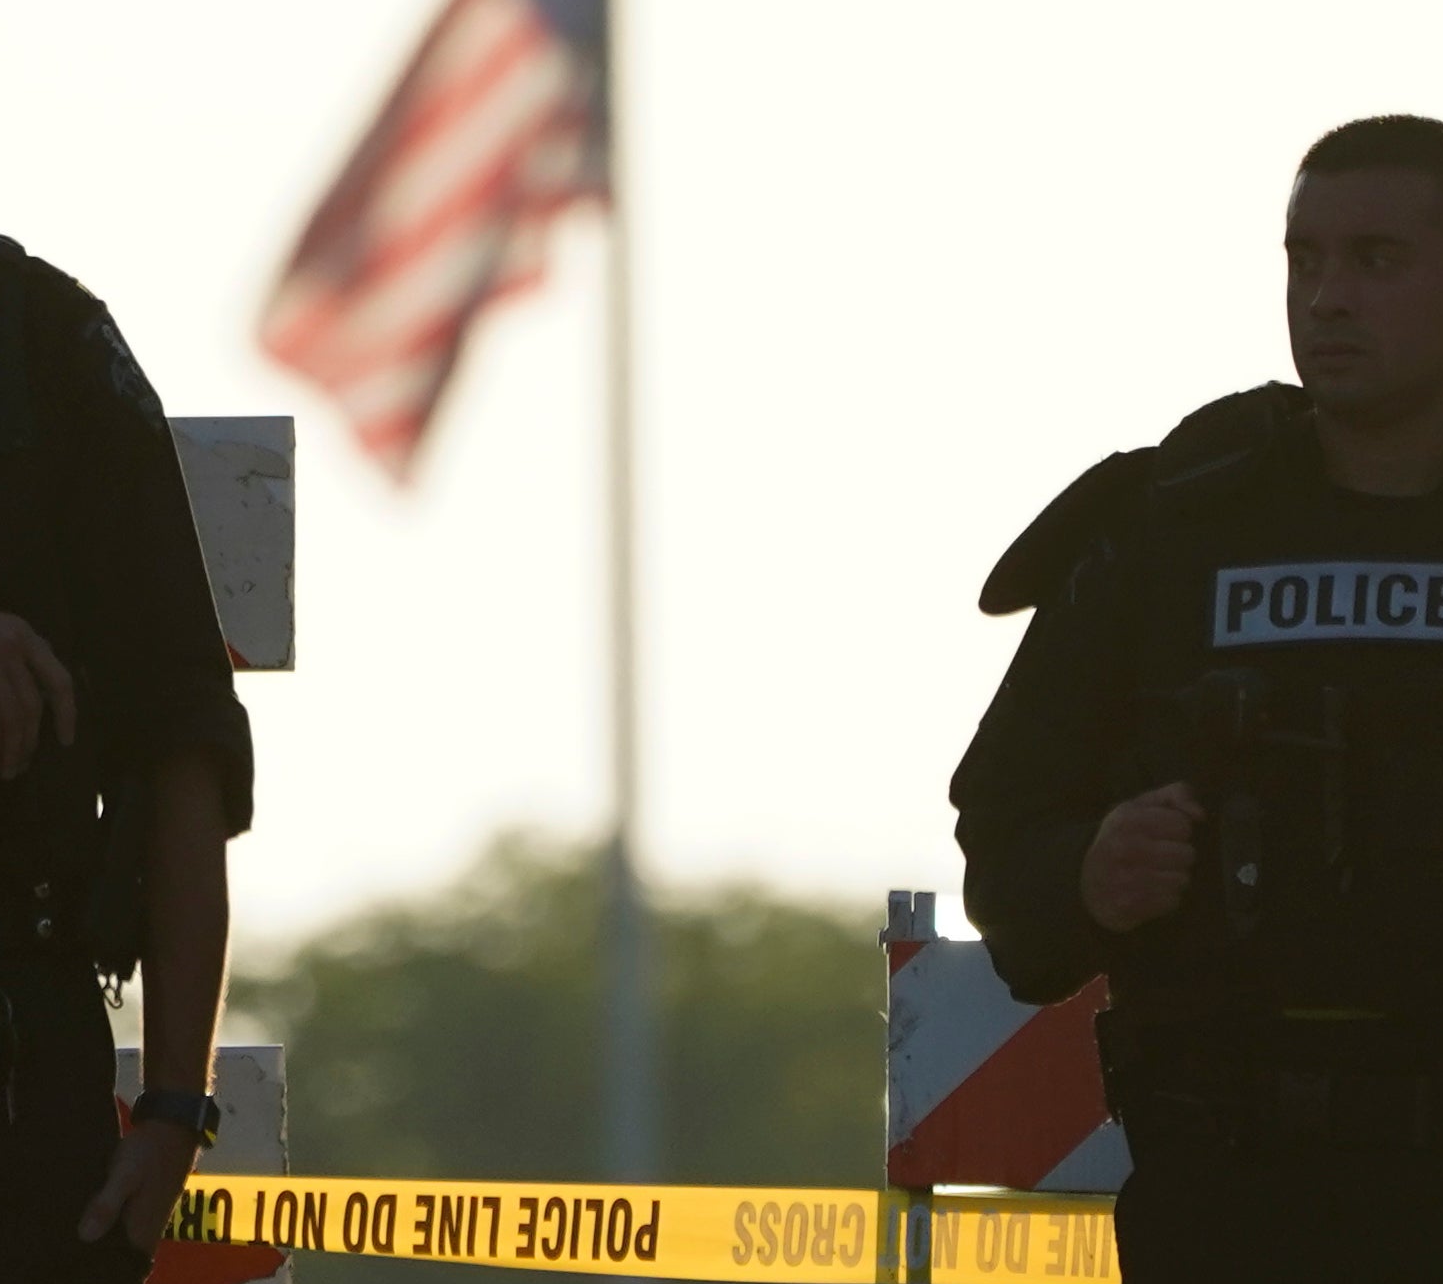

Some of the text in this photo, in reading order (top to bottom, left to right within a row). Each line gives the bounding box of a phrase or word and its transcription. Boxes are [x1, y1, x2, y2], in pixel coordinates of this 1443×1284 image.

[249, 1189, 328, 1251] NOT
[343, 1191, 398, 1255] DO
[412, 1193, 502, 1258] LINE
[514, 1195, 661, 1263] POLICE
[731, 1200, 867, 1269] CROSS
[975, 1206, 1032, 1275] DO
[1044, 1210, 1116, 1279] INE
